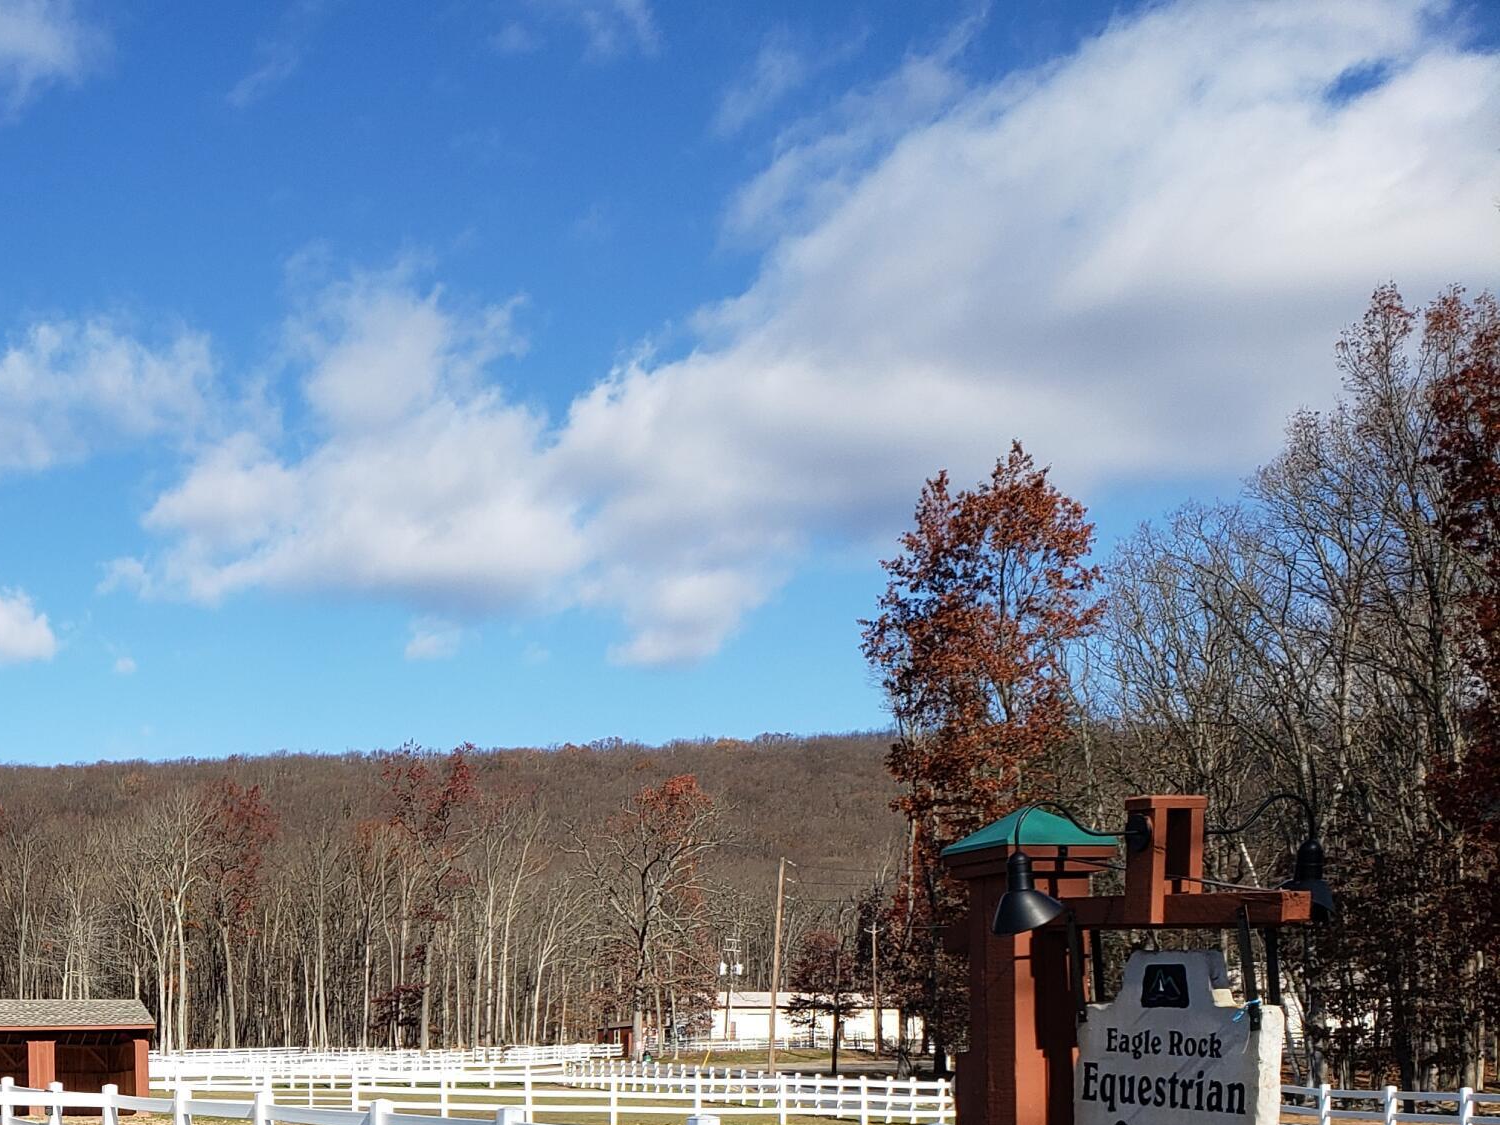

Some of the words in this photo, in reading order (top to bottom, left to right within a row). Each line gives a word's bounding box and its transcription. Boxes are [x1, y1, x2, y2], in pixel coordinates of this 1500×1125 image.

[1106, 1027, 1162, 1060] Eagle
[1169, 1031, 1222, 1058] Rock
[1082, 1061, 1246, 1115] Equestrian
